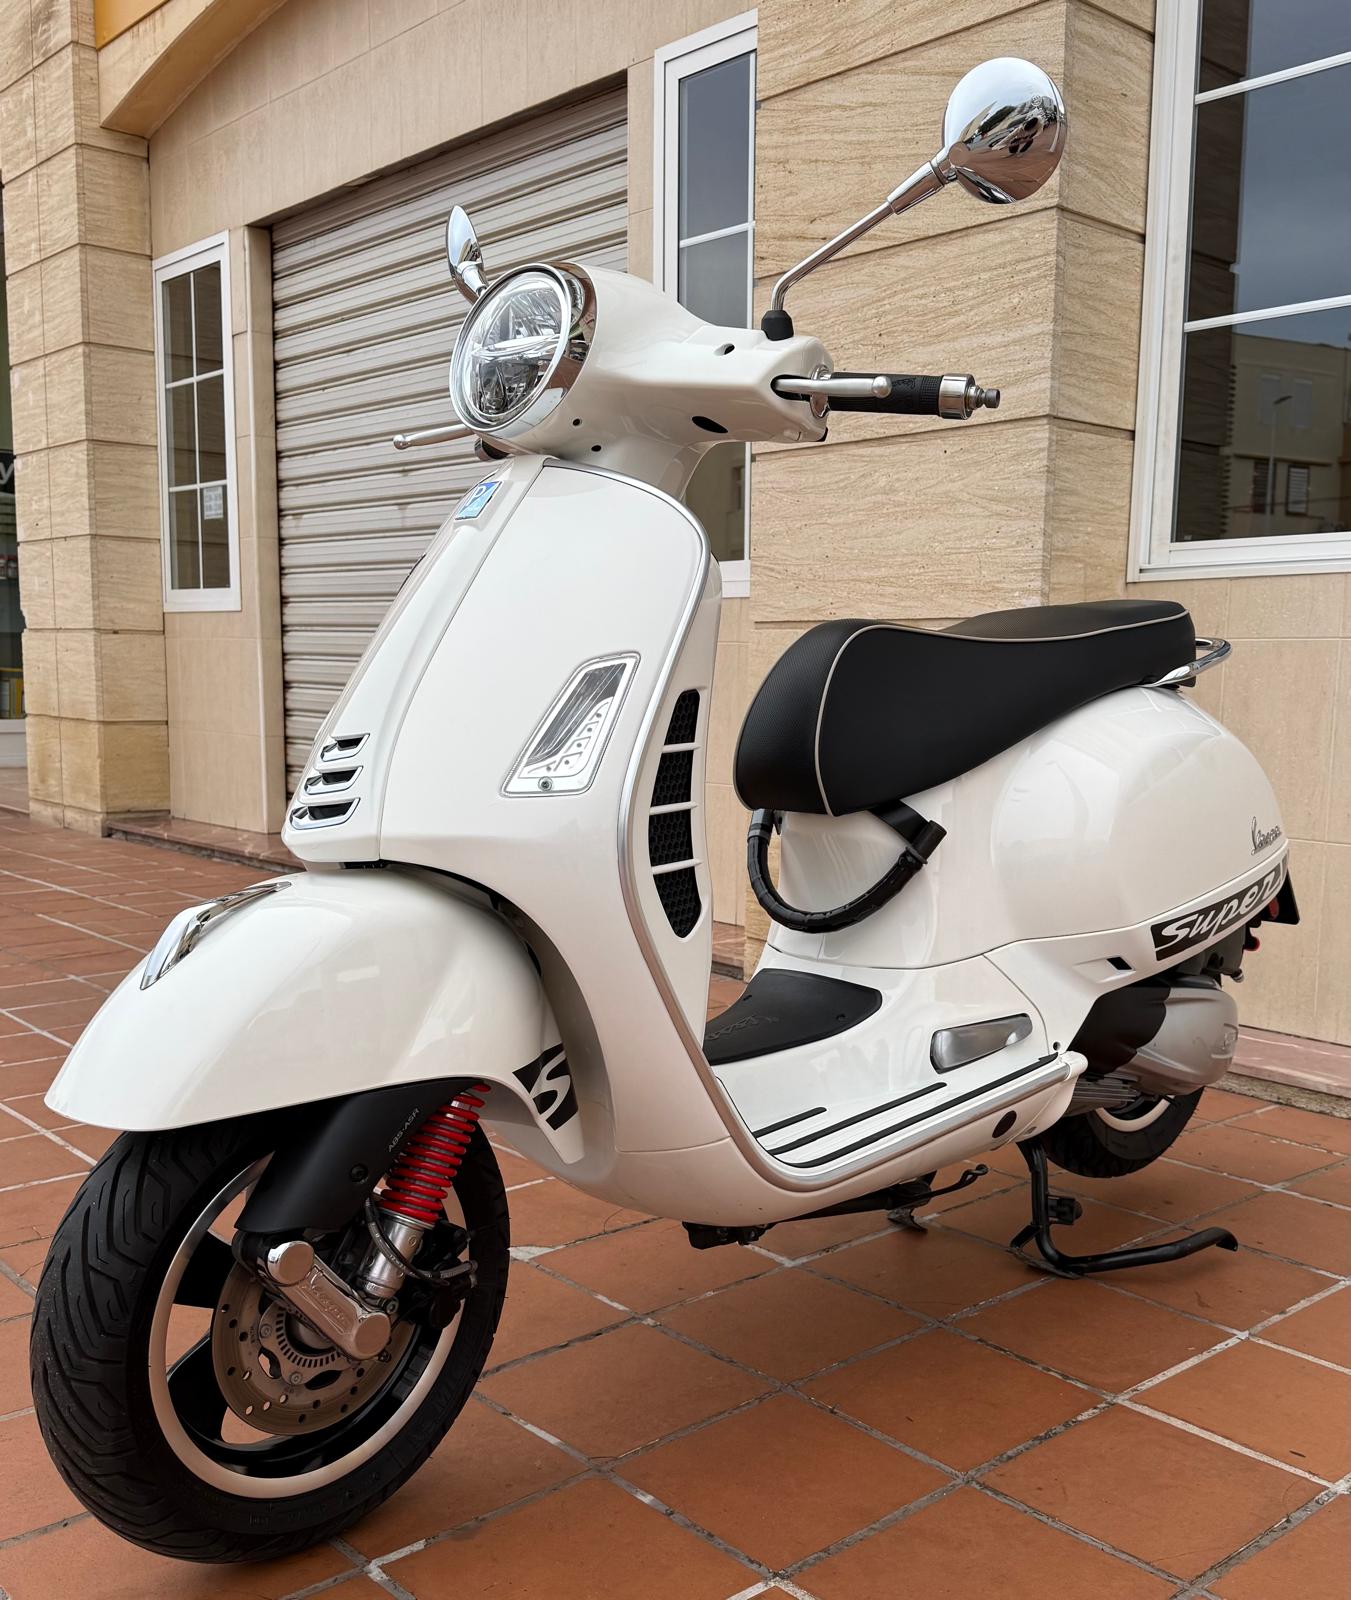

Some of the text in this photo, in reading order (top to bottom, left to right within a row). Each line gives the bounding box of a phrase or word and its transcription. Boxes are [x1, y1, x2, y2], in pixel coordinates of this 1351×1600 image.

[1250, 816, 1282, 856] Vespa
[1154, 857, 1284, 951] Super
[529, 1050, 571, 1120] S
